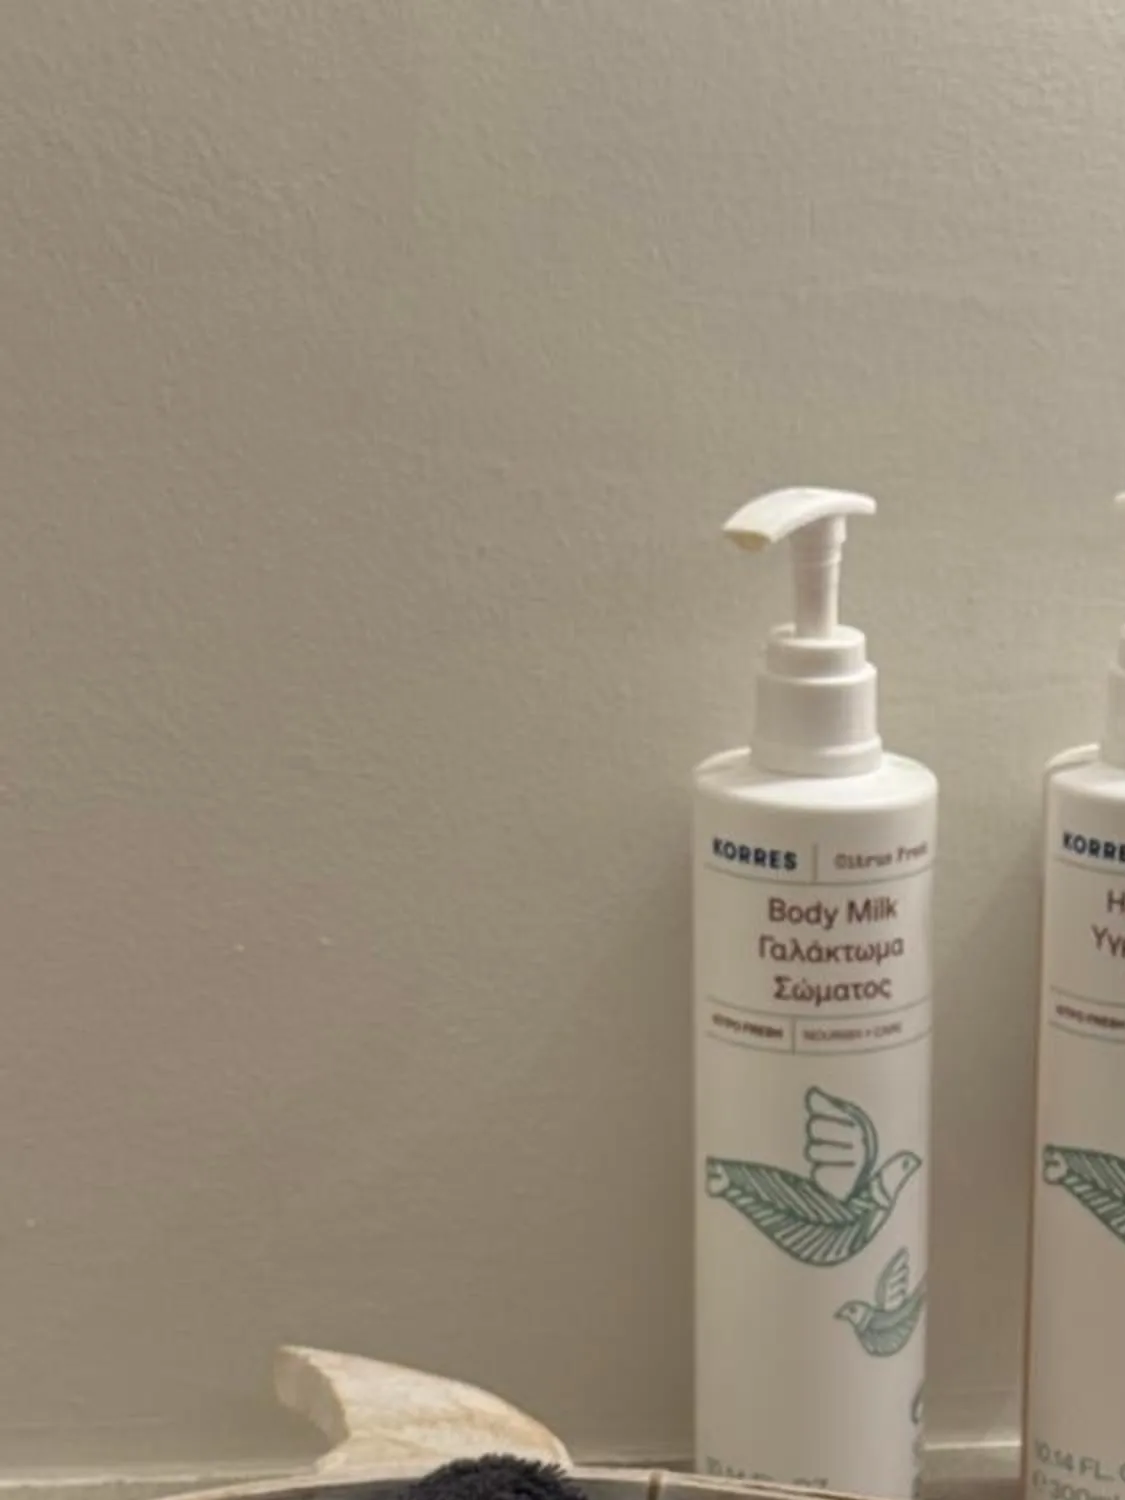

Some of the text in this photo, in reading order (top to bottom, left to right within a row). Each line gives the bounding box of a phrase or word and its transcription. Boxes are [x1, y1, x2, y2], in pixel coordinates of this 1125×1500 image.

[712, 837, 798, 871] KORRES
[768, 896, 898, 930] Body Milk
[758, 934, 905, 965] Γαλάκτωμα
[772, 974, 893, 1007] Σώματος
